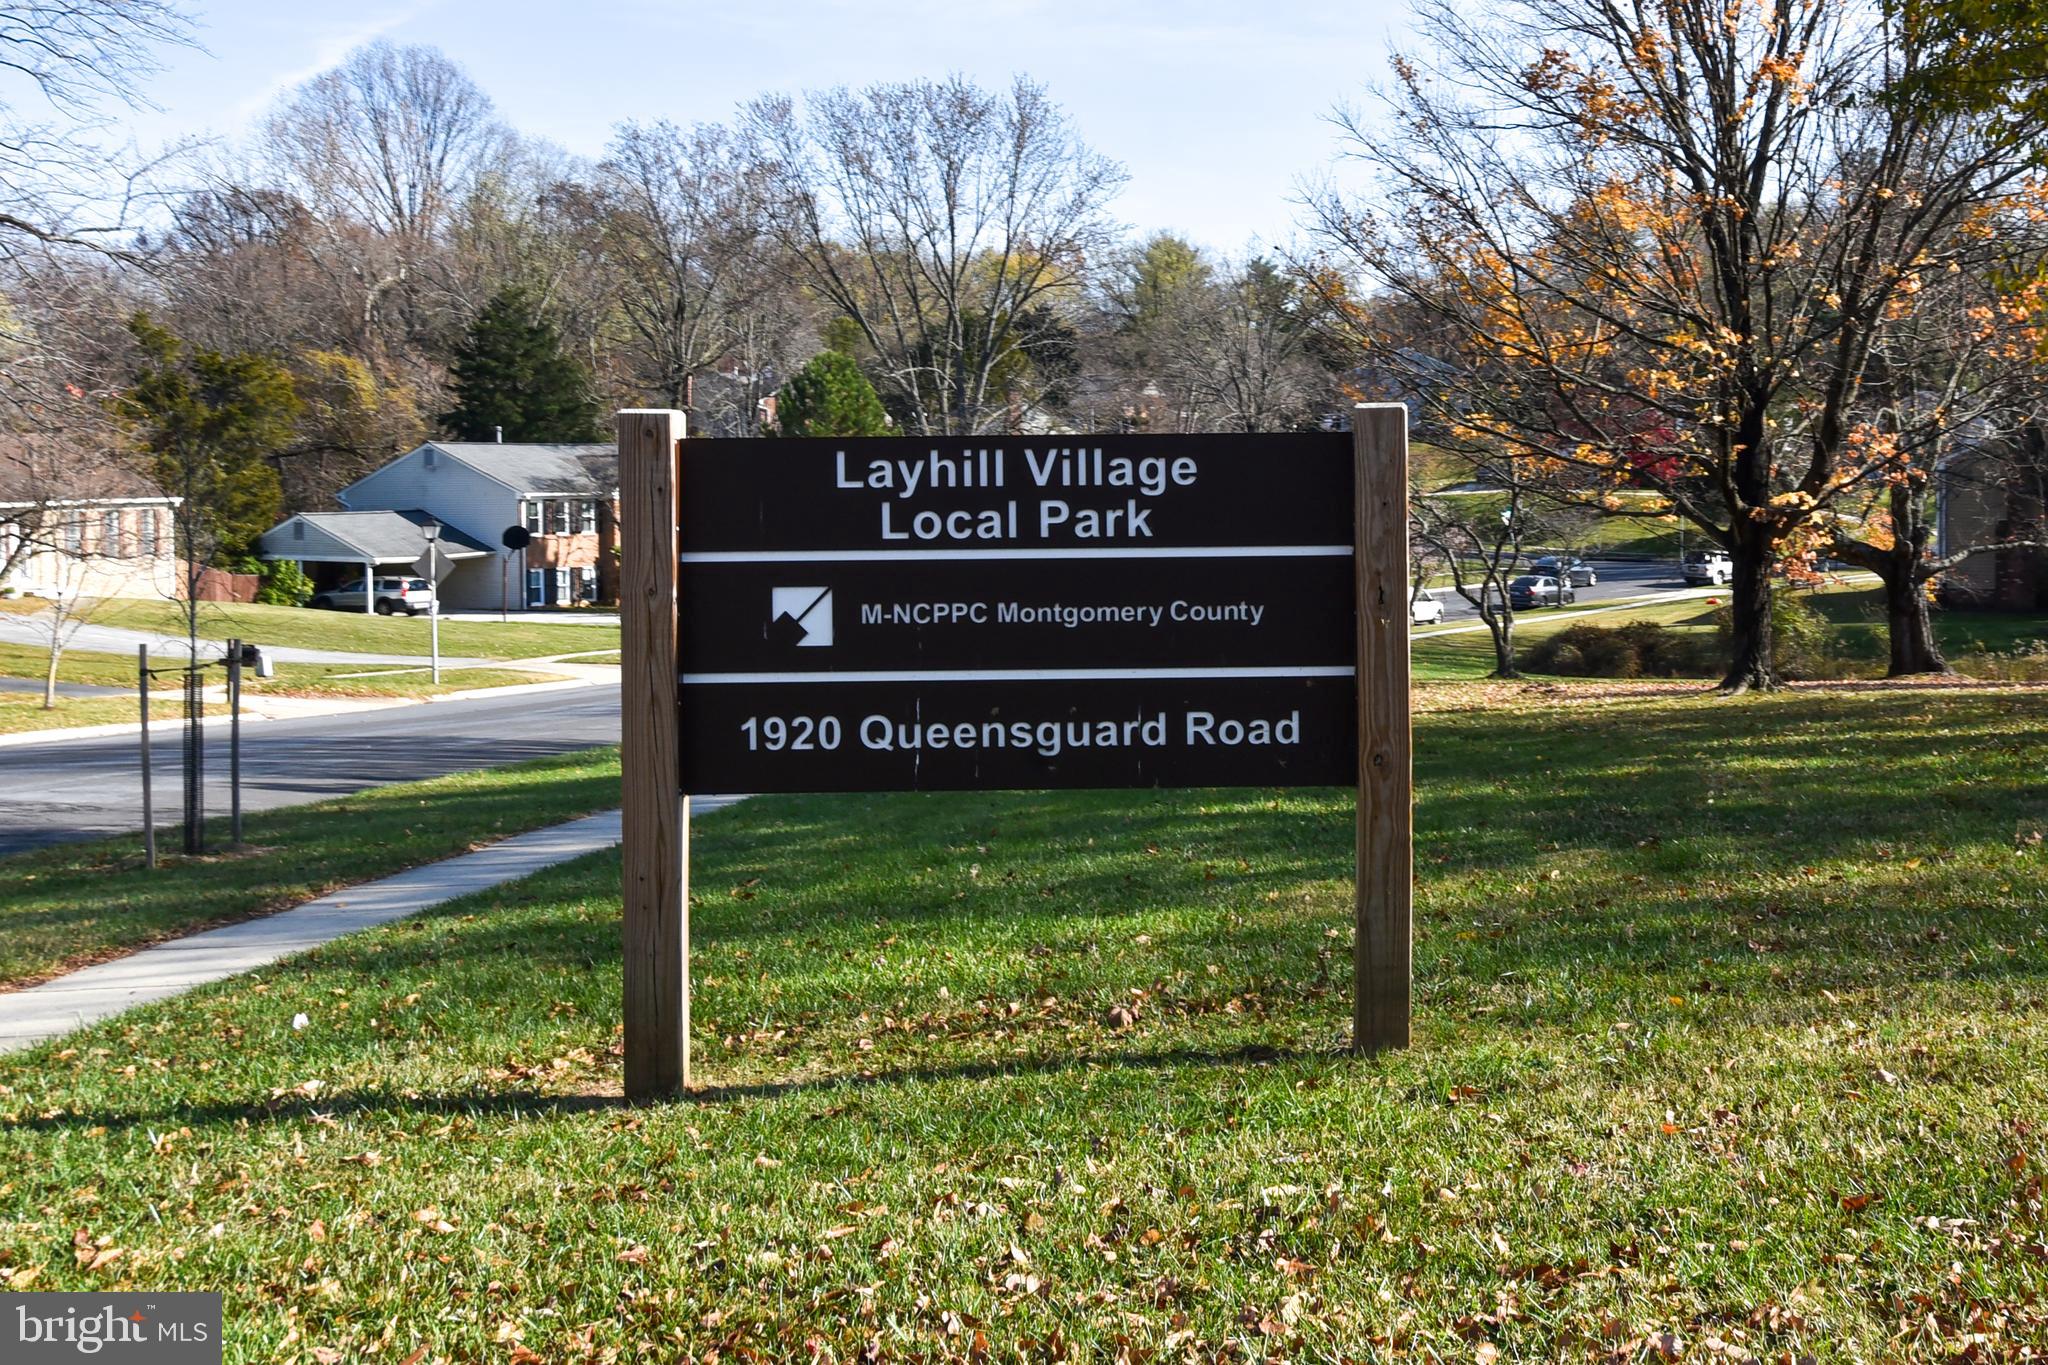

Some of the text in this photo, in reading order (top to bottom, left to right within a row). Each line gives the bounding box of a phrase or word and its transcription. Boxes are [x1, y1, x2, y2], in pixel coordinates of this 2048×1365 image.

[836, 448, 1197, 499] Layhill Village
[881, 499, 1154, 540] Local Park
[861, 599, 1265, 629] M-NCPPC Montgomery County
[740, 710, 1300, 757] 1920 Queensguard Road
